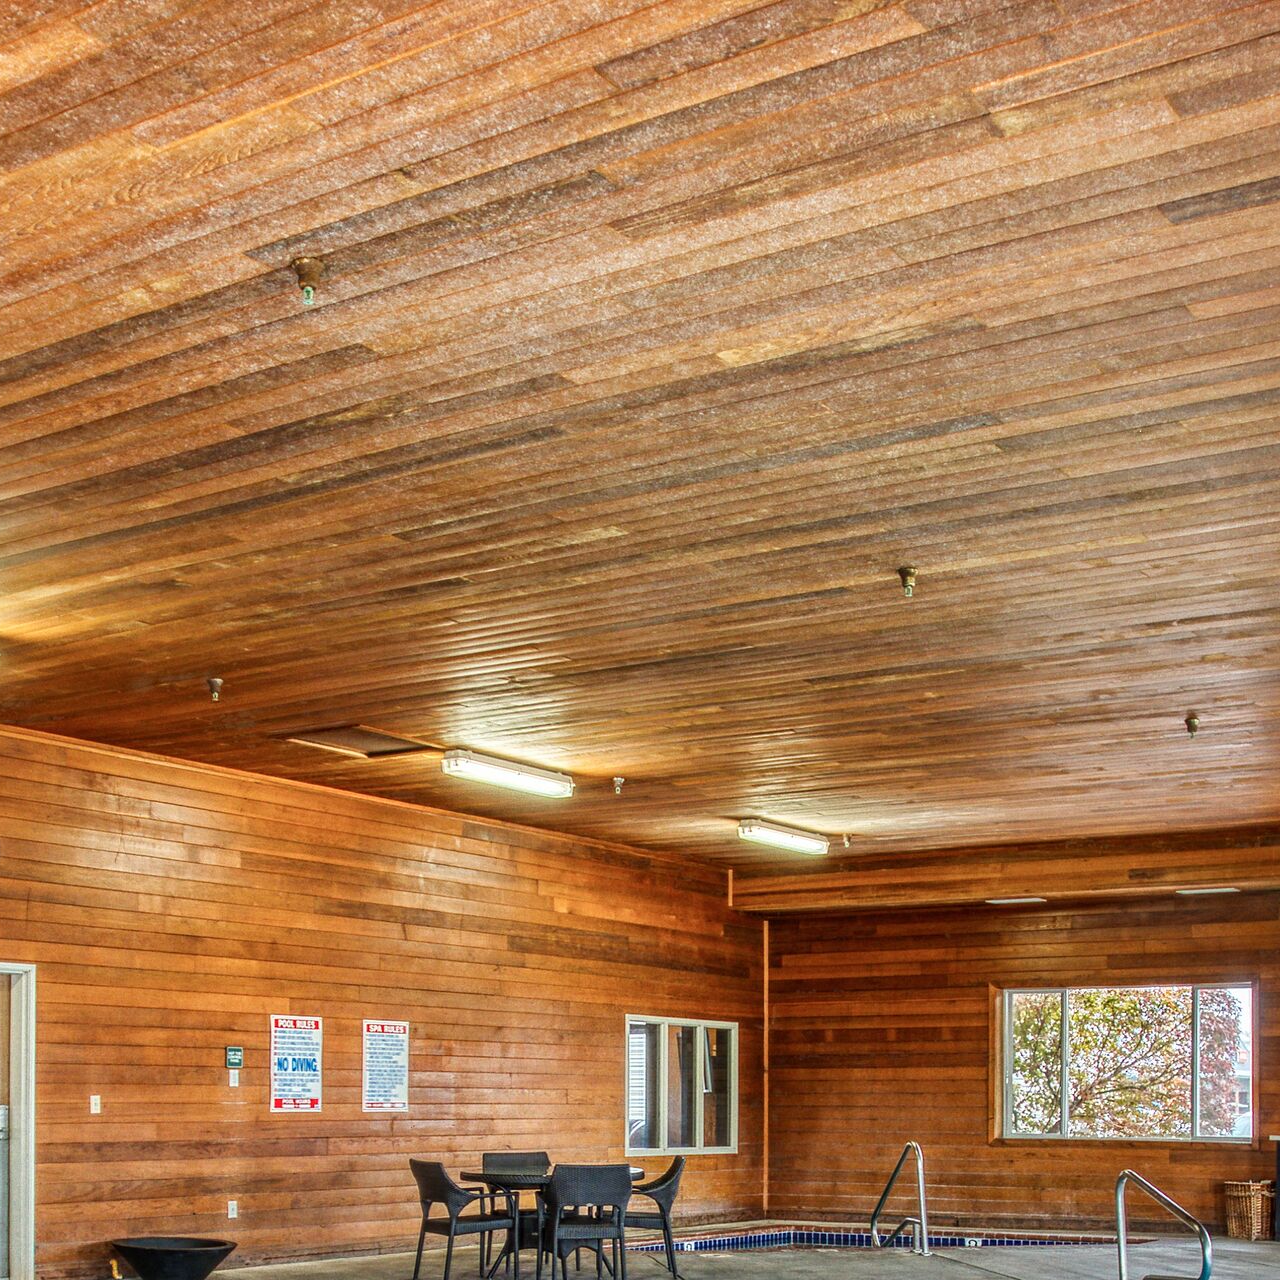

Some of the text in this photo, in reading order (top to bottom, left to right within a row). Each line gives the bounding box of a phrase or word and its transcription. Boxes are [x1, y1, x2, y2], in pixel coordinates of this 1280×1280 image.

[278, 1019, 315, 1029] POOL RULES
[369, 1024, 405, 1034] SPA RULES
[277, 1057, 289, 1072] NO
